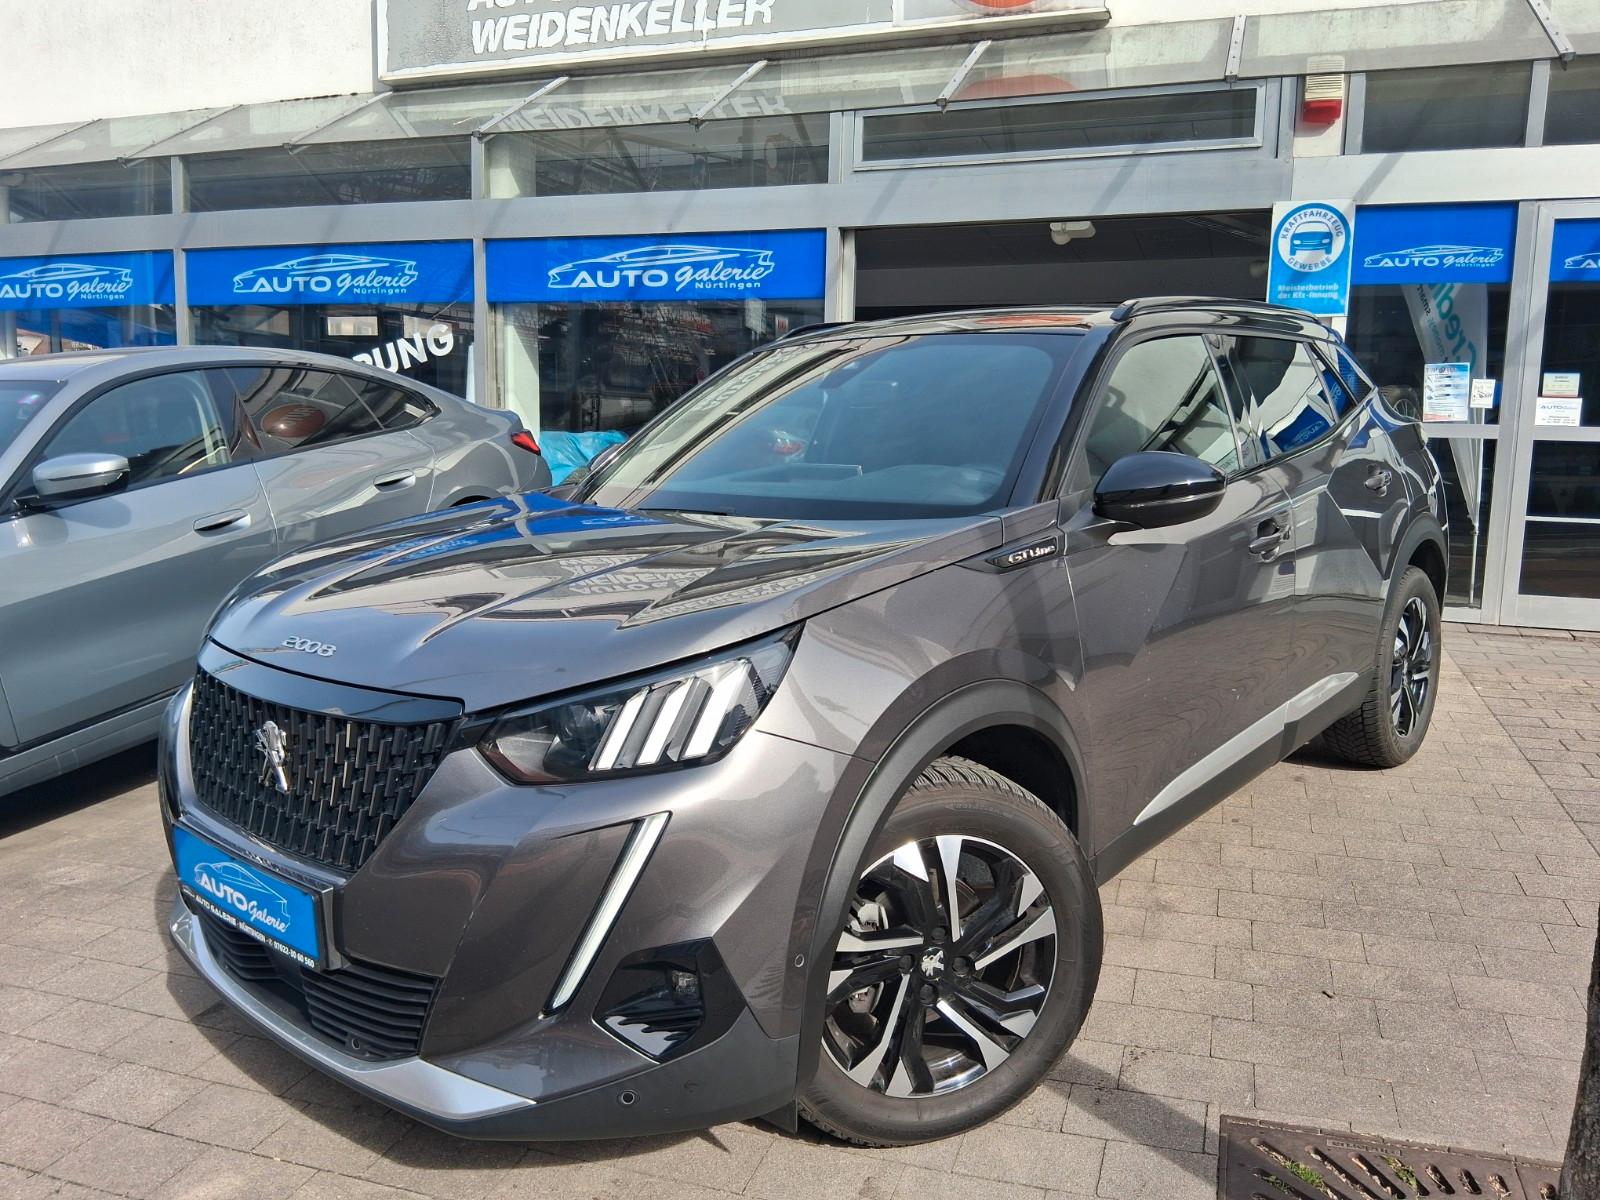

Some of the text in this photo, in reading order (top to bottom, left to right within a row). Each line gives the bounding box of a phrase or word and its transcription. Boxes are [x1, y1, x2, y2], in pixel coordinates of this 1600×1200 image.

[472, 0, 775, 54] WEIDENKELLER
[1281, 210, 1343, 239] KRAFTFAHRZEUG
[1288, 256, 1331, 271] GEWERBE
[1380, 257, 1440, 267] AUTO
[252, 269, 412, 296] AUTO galerie
[571, 261, 766, 292] AUTO galerie
[695, 280, 761, 290] Nürtingen
[0, 277, 130, 301] AUTO galerie
[81, 292, 125, 301] Nürtingen
[353, 287, 407, 295] Nürtingen
[281, 635, 337, 657] 2008
[200, 872, 288, 933] AUTO Galerie
